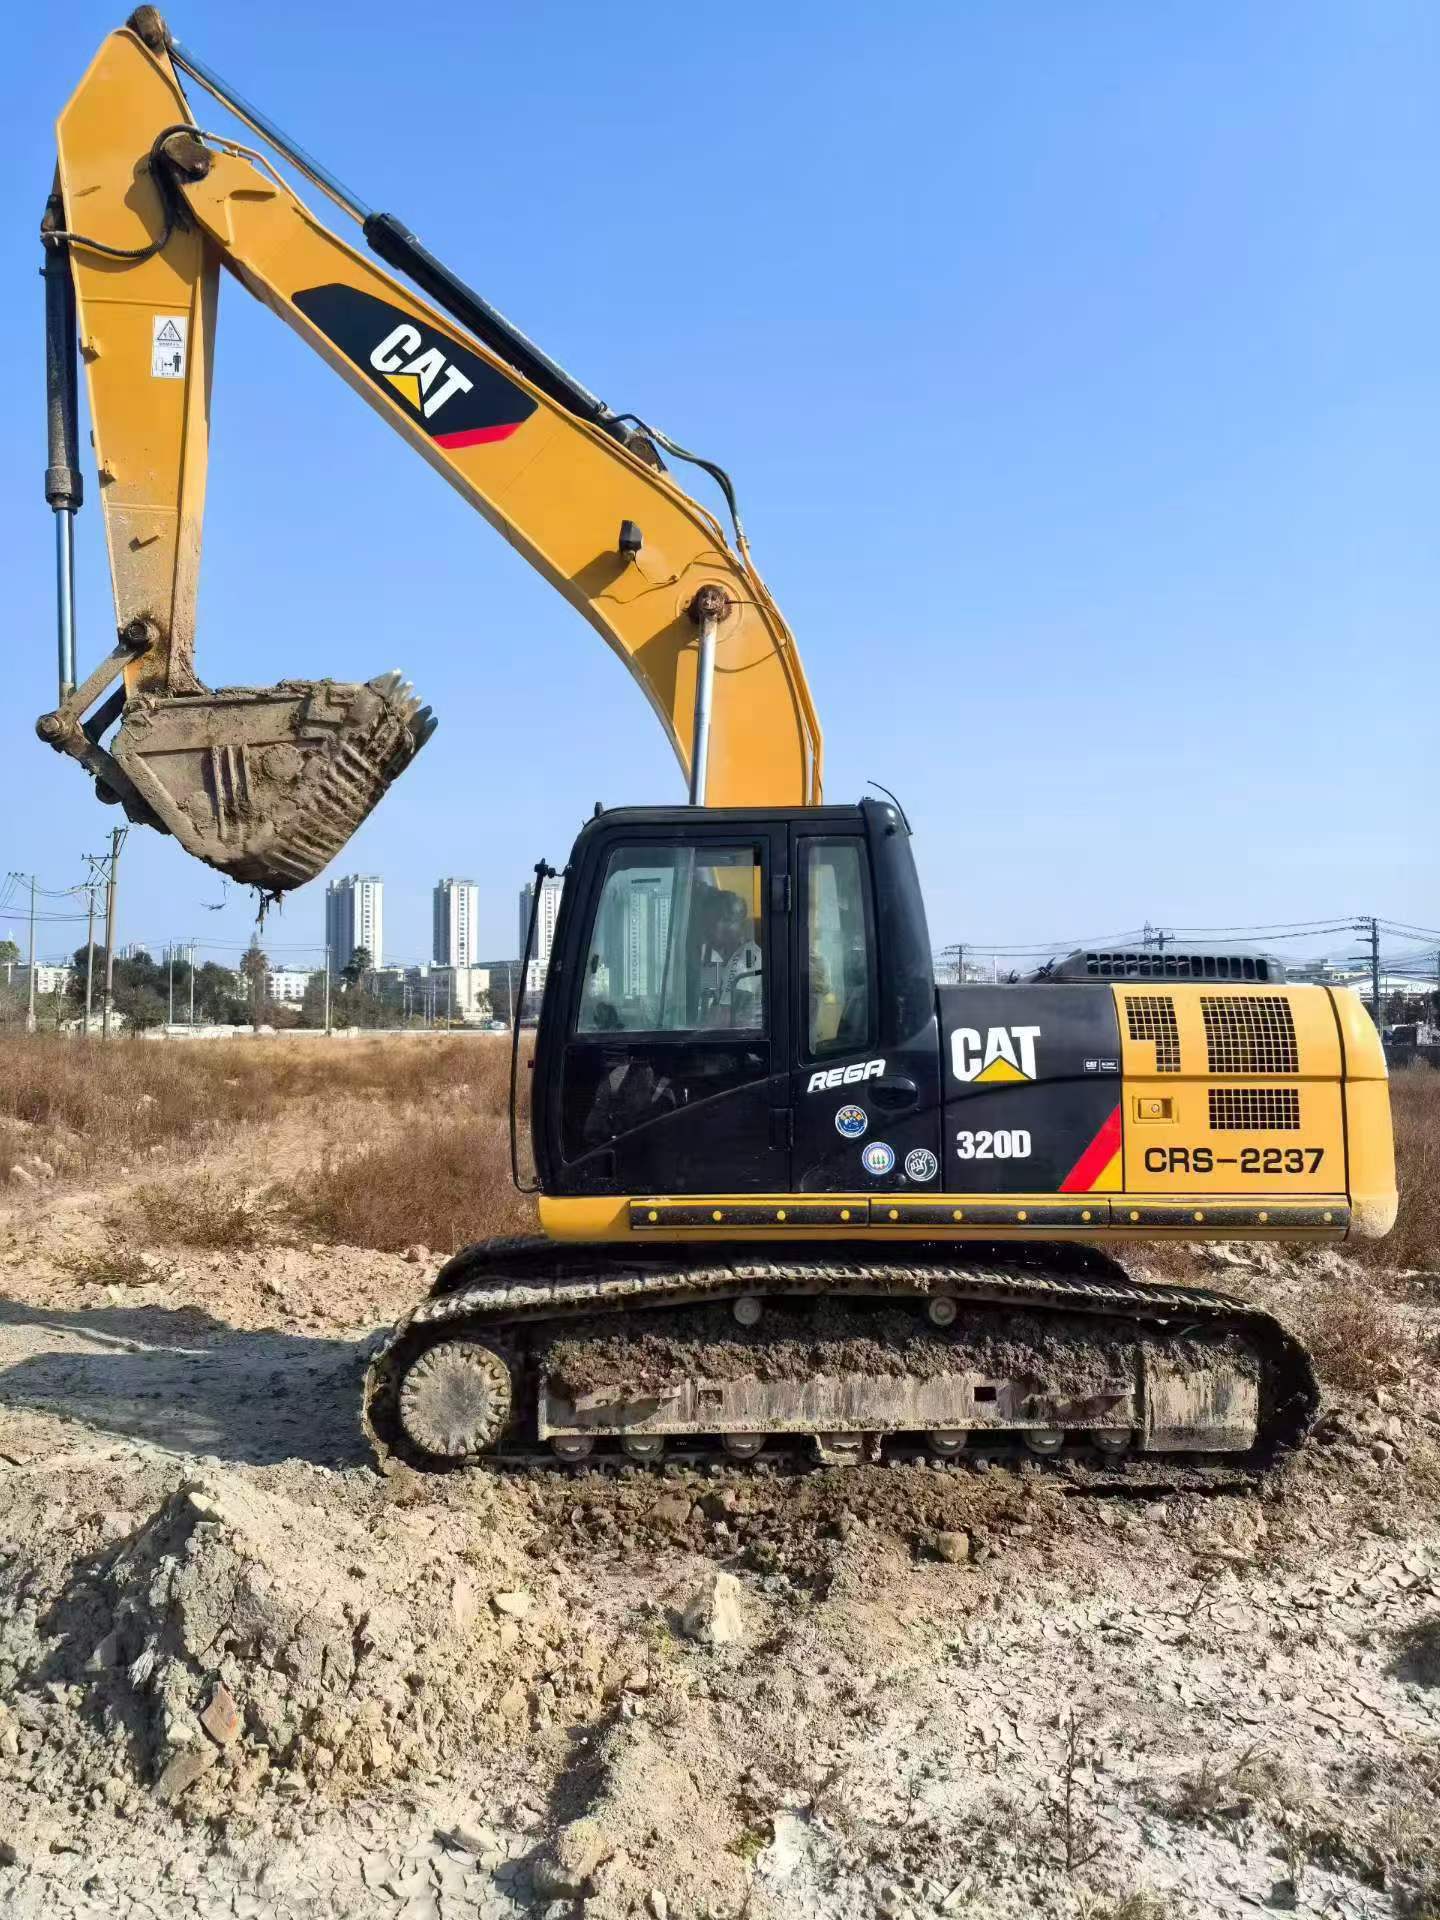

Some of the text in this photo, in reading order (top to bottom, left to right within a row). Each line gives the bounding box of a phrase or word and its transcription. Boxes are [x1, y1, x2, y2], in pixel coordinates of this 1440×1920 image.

[370, 324, 474, 418] CAT
[951, 1026, 1041, 1081] CAT
[806, 1058, 886, 1092] REGA
[957, 1129, 1032, 1160] 320D
[1144, 1147, 1325, 1174] CRS-2237
